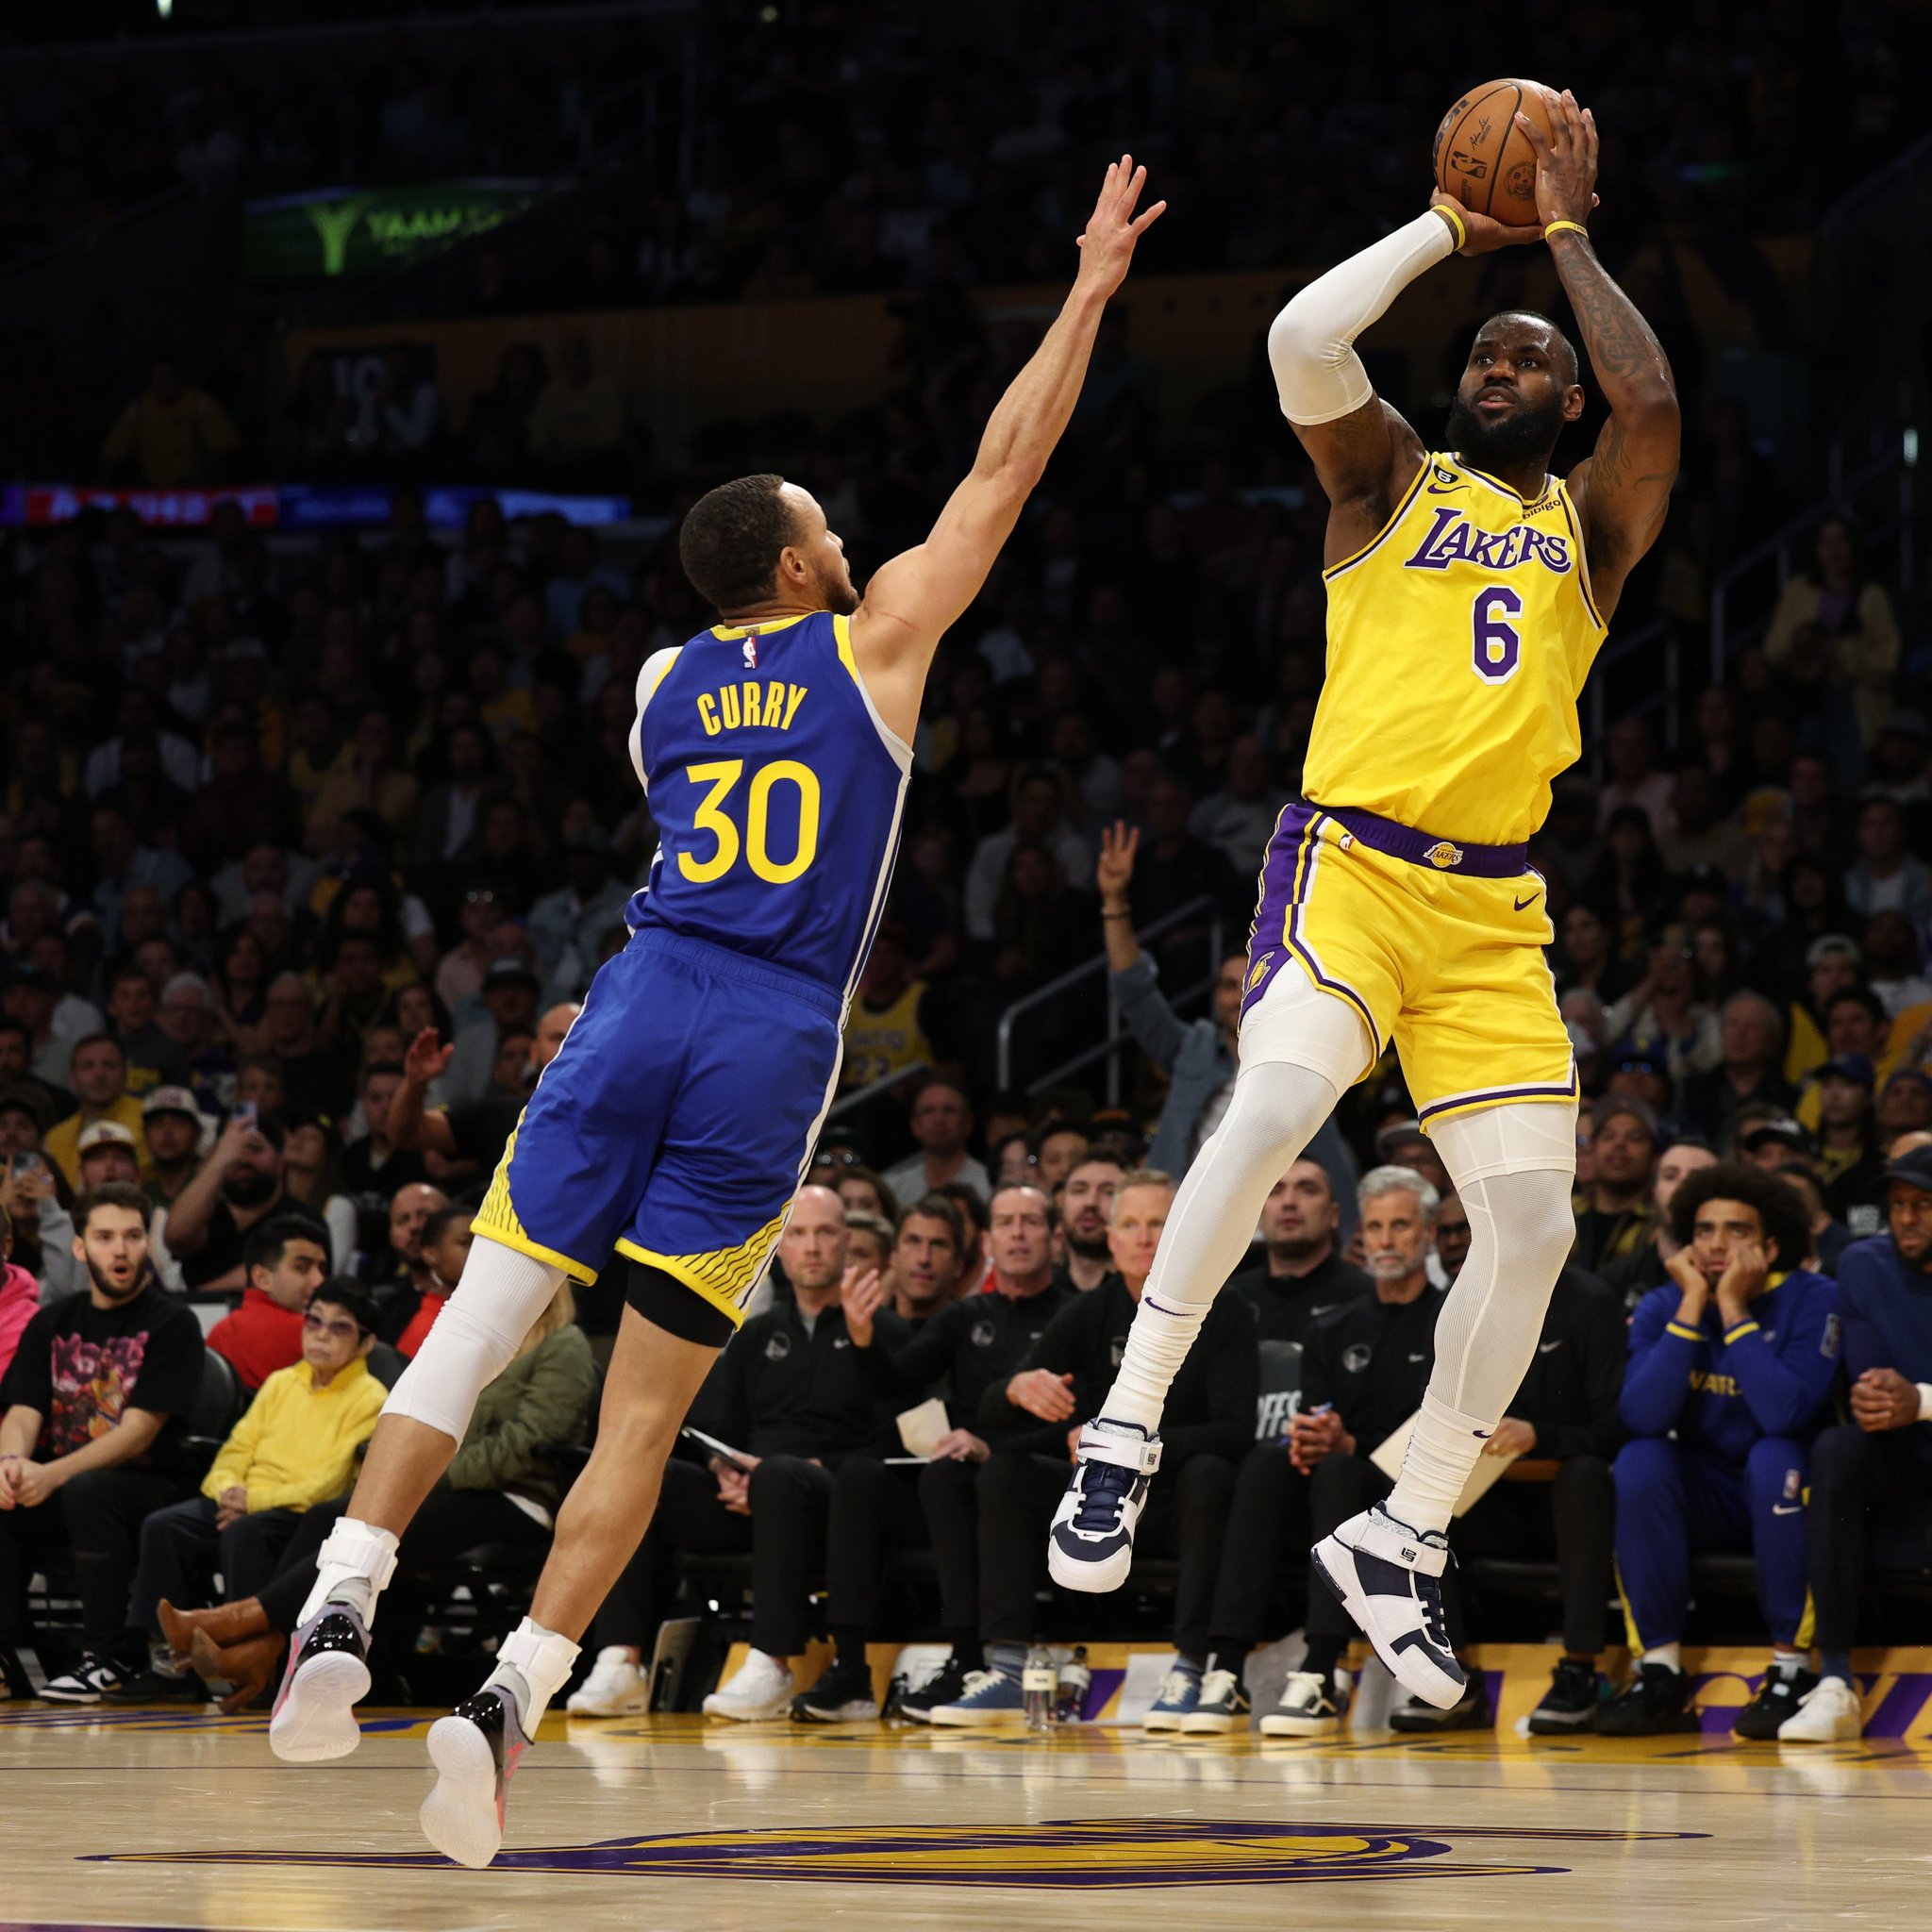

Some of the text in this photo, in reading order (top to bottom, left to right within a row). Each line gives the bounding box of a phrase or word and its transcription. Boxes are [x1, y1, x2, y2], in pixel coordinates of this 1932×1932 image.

[1523, 499, 1561, 520] bibigo
[1403, 507, 1573, 575] LAKERS
[1472, 585, 1524, 686] 6
[696, 681, 808, 736] CURRY
[677, 758, 821, 884] 30
[1426, 846, 1462, 864] LAKERS
